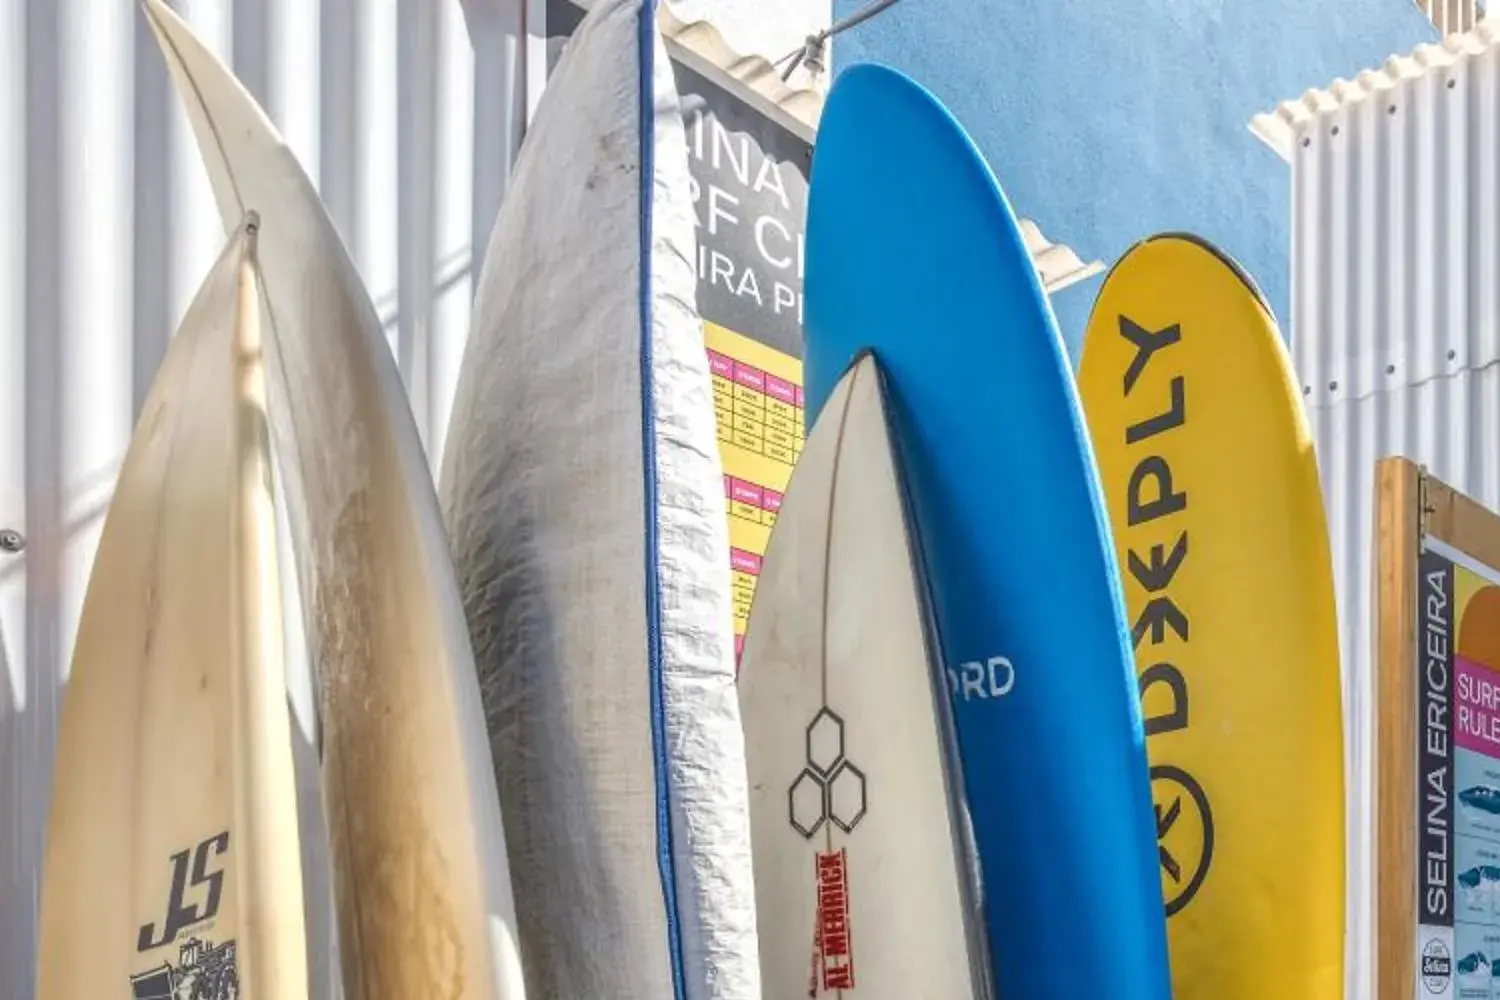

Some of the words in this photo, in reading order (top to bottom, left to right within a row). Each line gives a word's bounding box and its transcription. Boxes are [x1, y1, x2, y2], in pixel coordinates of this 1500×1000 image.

[685, 108, 790, 210] INA
[947, 656, 1015, 702] RD
[1427, 570, 1447, 757] ERICEIRA
[137, 831, 229, 952] JS
[1427, 766, 1447, 915] SELINA
